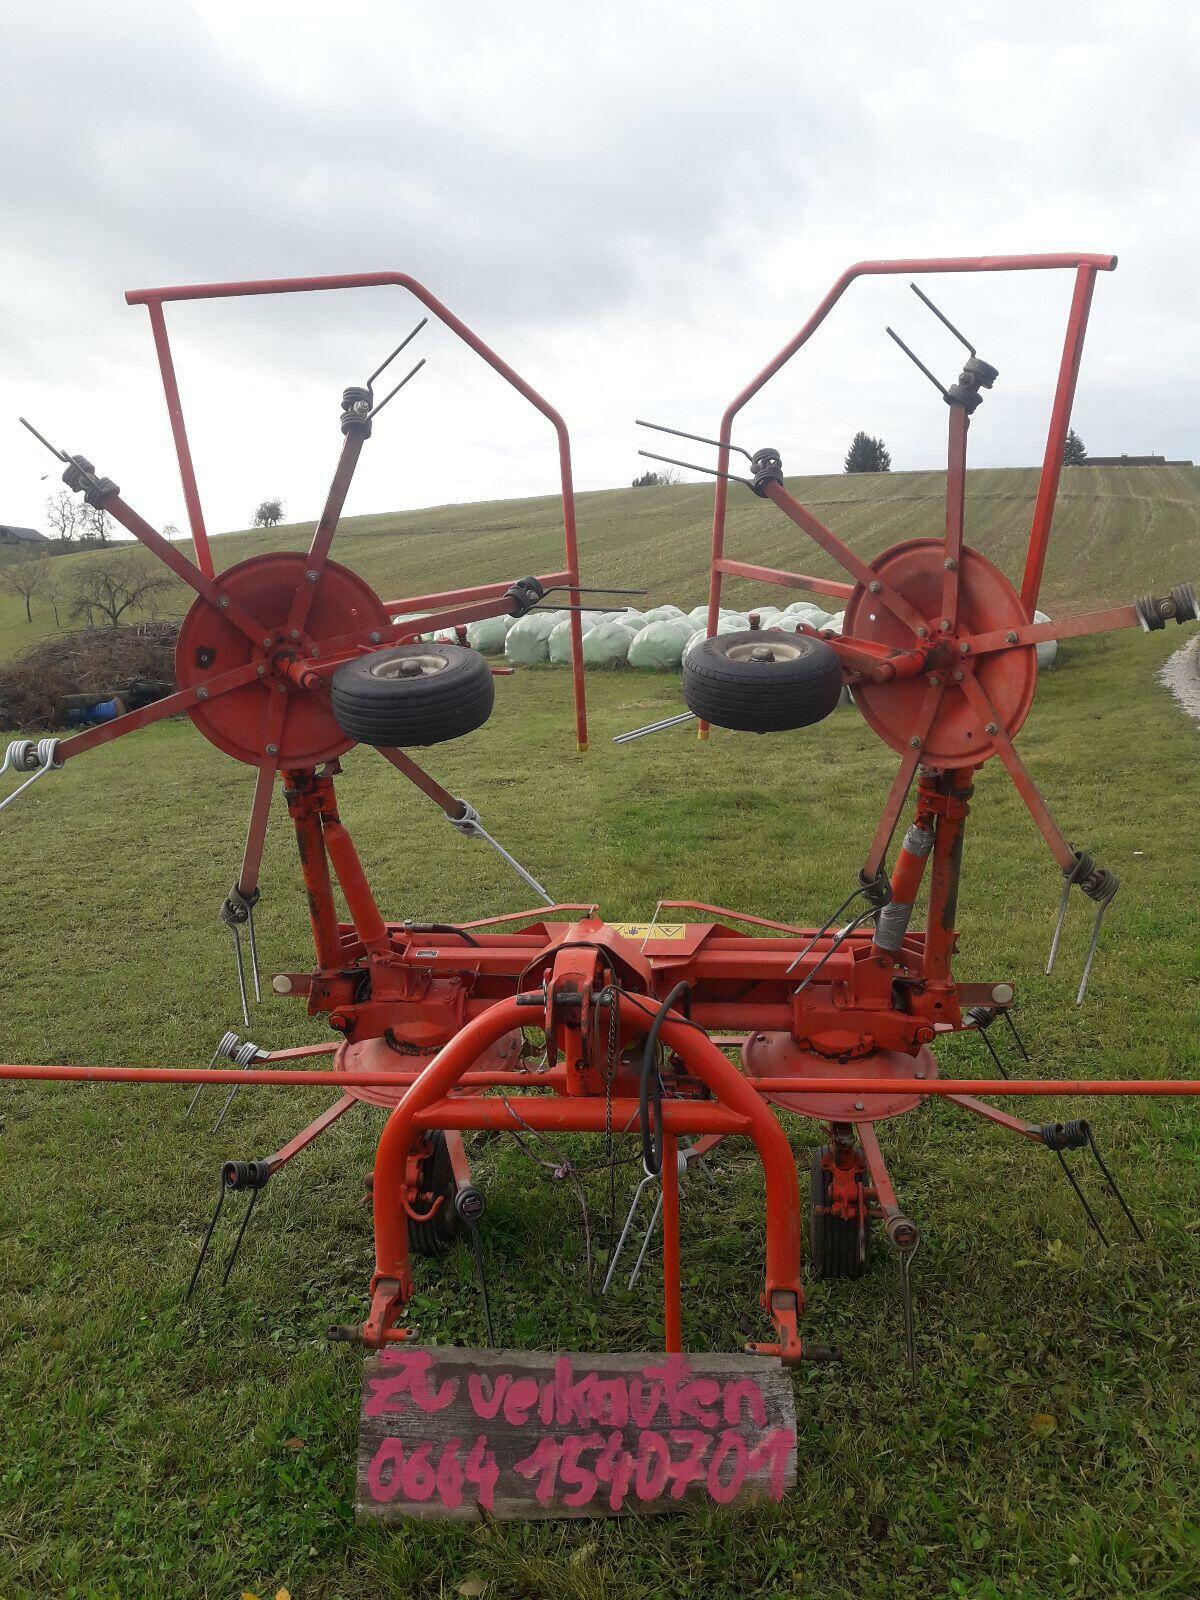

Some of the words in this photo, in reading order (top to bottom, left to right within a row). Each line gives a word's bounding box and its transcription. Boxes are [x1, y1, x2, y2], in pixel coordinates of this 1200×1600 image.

[364, 1349, 460, 1417] Zu
[368, 1434, 500, 1511] 0664
[512, 1429, 796, 1512] 1540701
